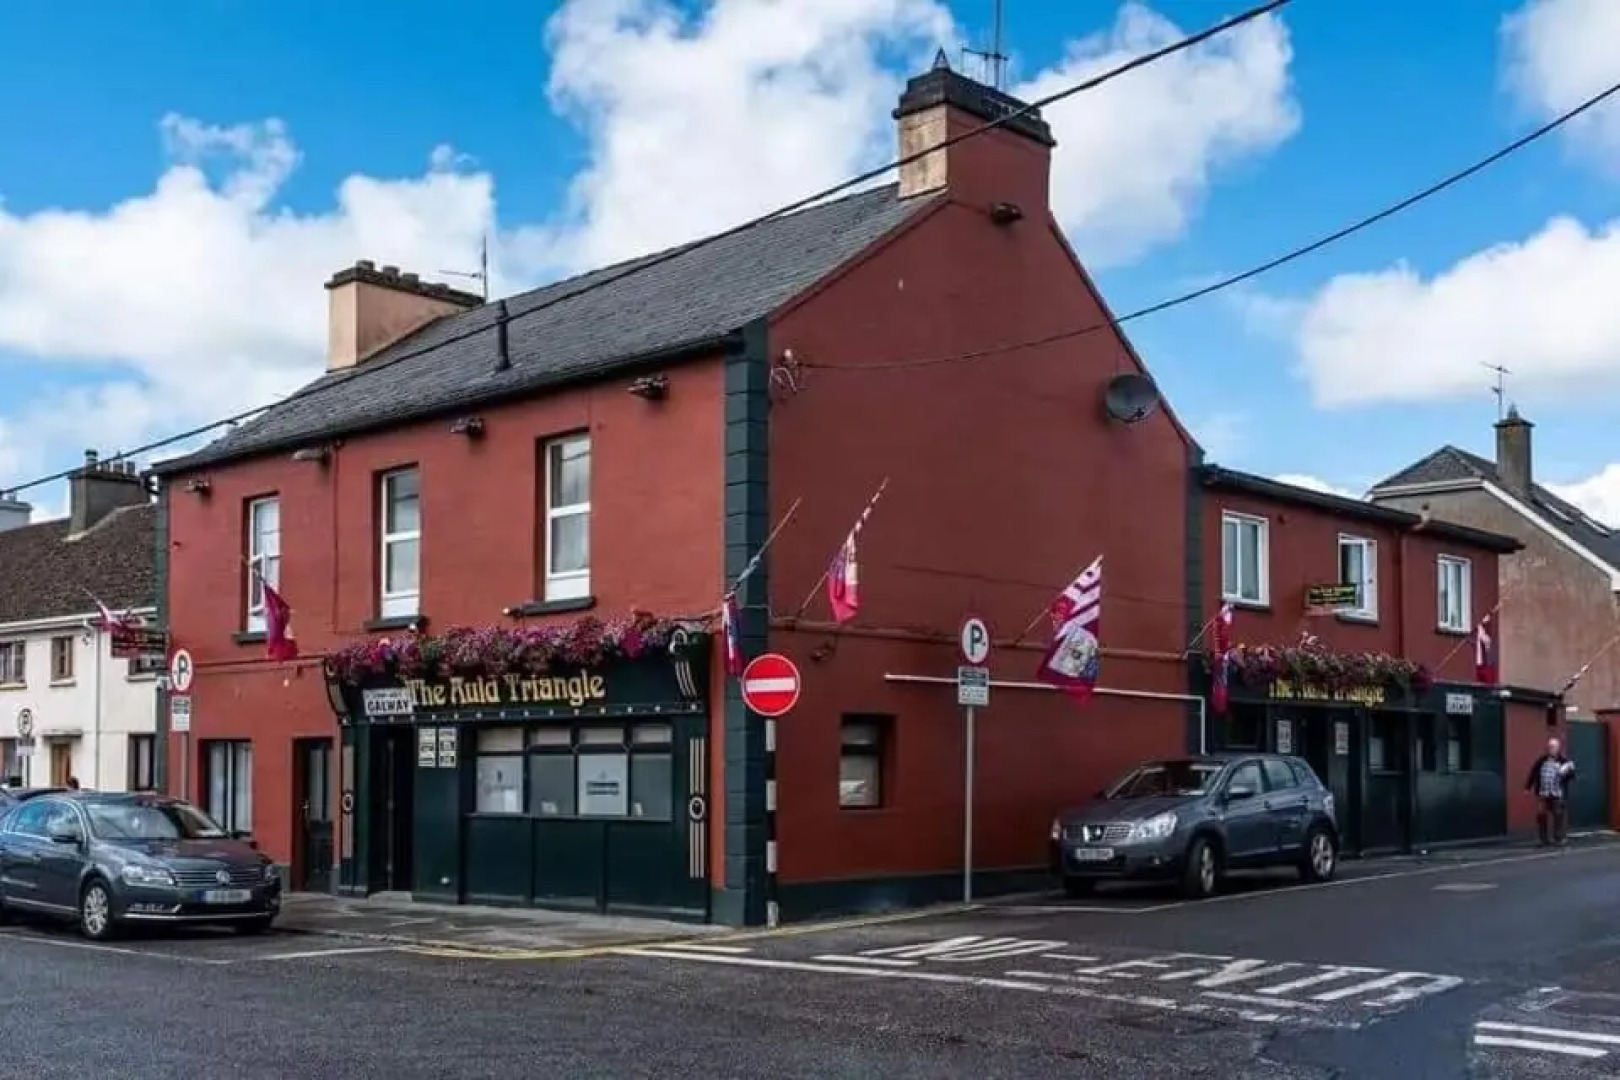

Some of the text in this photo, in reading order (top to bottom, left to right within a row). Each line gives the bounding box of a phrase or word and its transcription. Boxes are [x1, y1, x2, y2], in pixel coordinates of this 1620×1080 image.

[971, 624, 983, 656] P
[178, 654, 188, 686] P
[404, 668, 606, 706] The Auld Triangle
